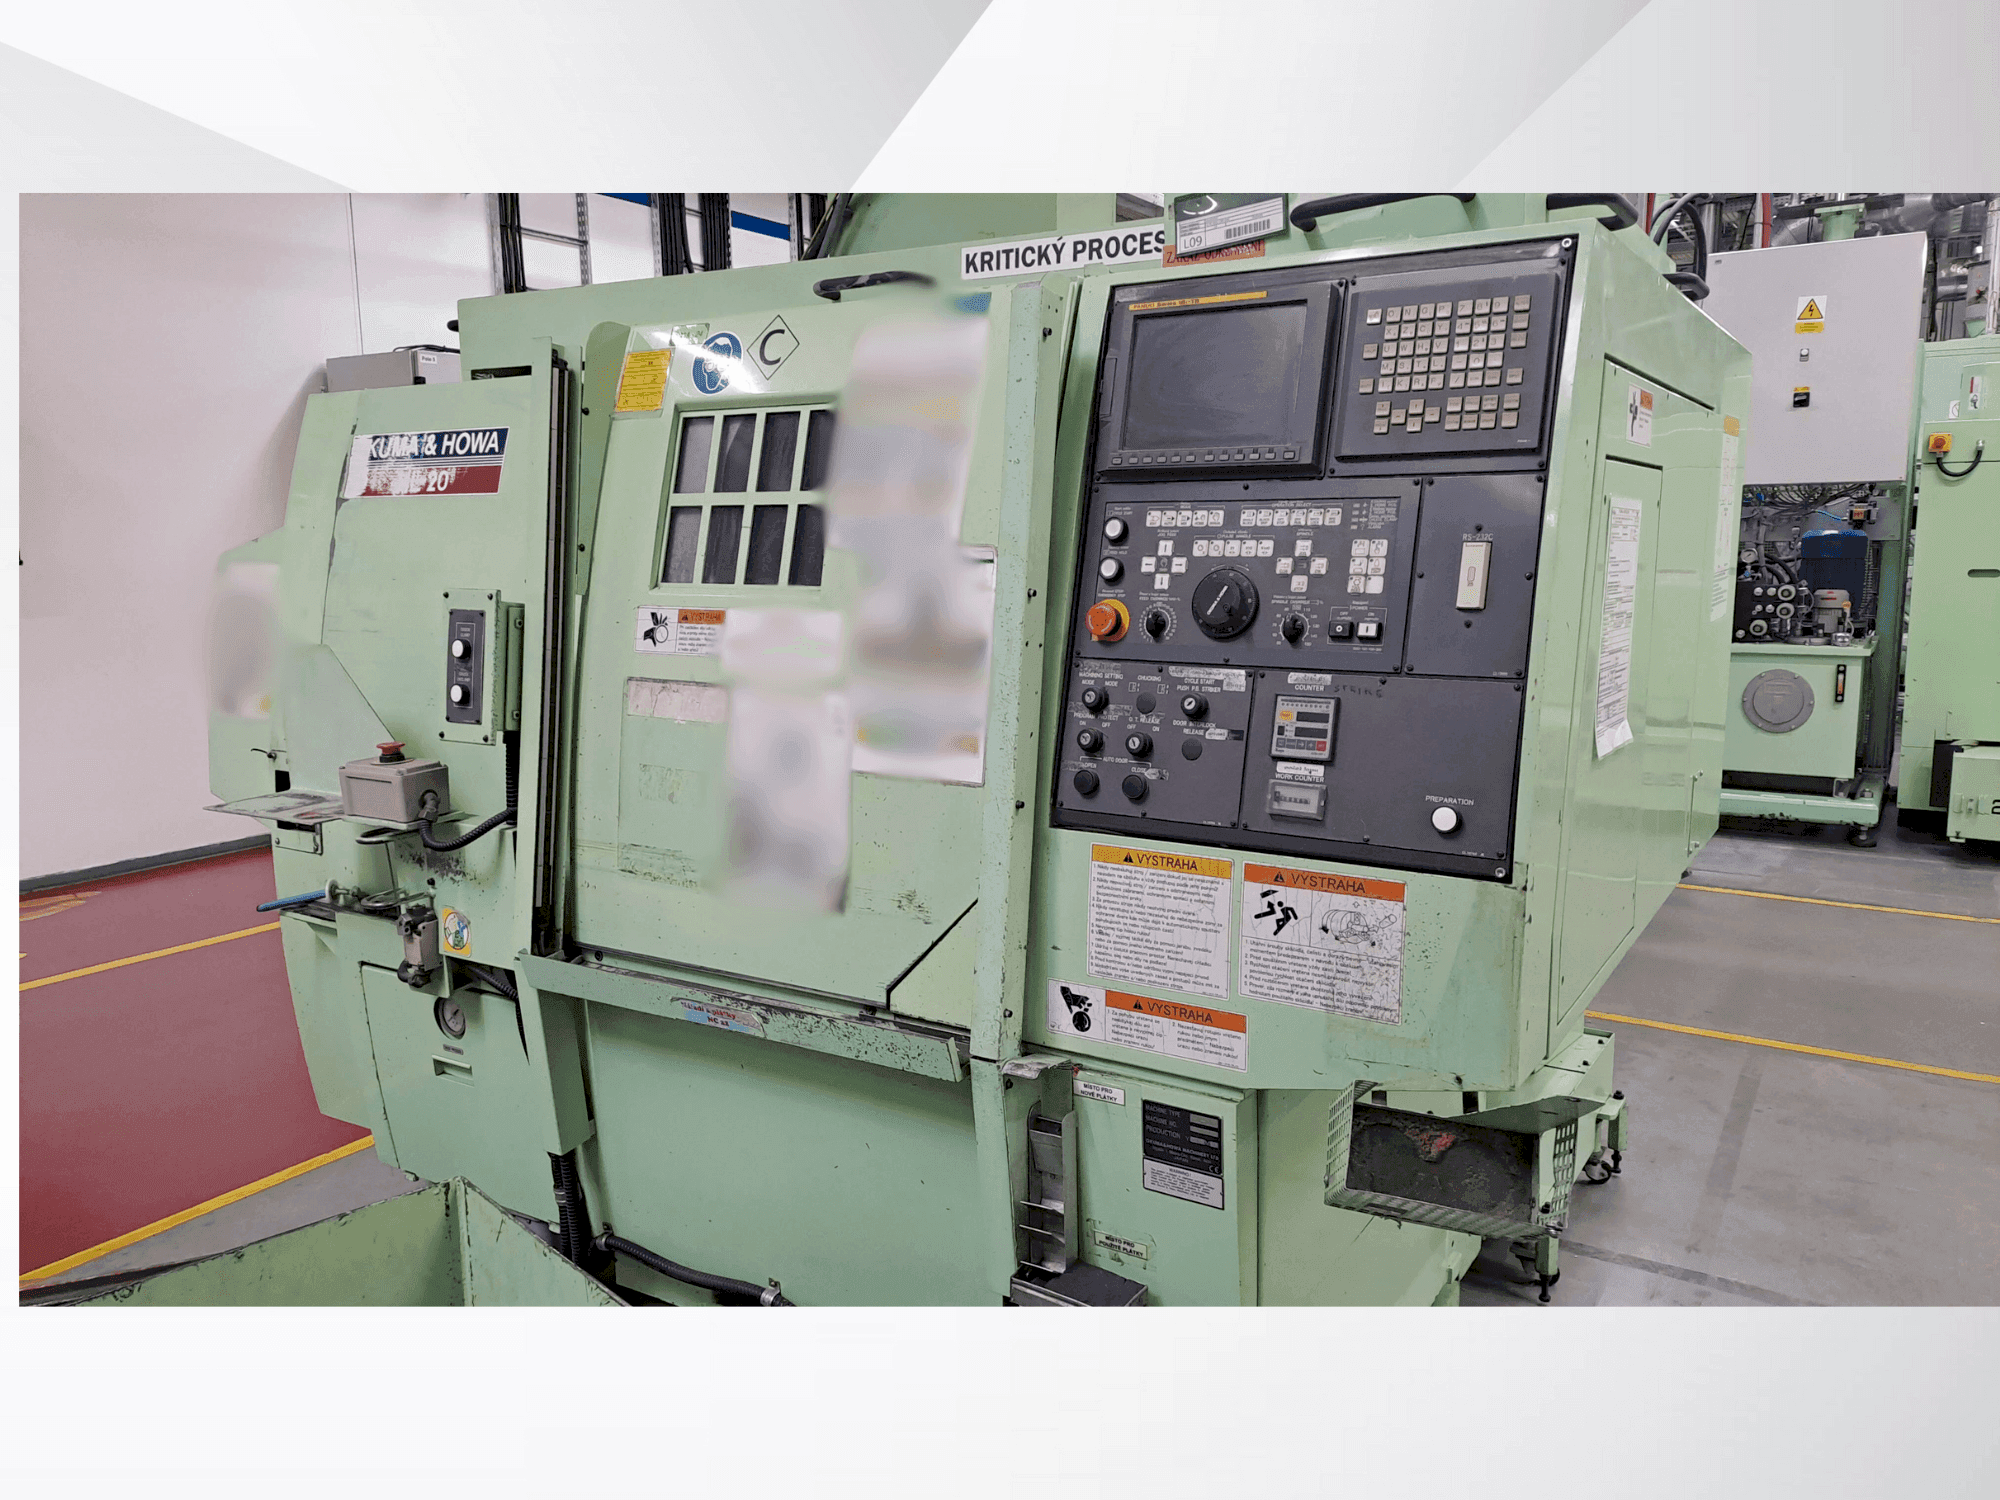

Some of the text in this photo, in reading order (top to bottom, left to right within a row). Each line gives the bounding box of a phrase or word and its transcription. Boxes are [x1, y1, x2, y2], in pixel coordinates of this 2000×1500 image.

[1183, 235, 1203, 250] L09
[965, 236, 1066, 274] KRITICKÝ
[759, 329, 786, 366] C
[364, 436, 420, 460] KUMA
[441, 431, 500, 456] HOWA
[1463, 533, 1494, 541] RS-232C
[1294, 684, 1325, 692] COUNTER
[1275, 772, 1325, 783] WORK COUNTER
[1425, 795, 1475, 806] PREPARATION
[1168, 1109, 1181, 1118] TYPE
[1145, 1124, 1181, 1140] PRODUCTION
